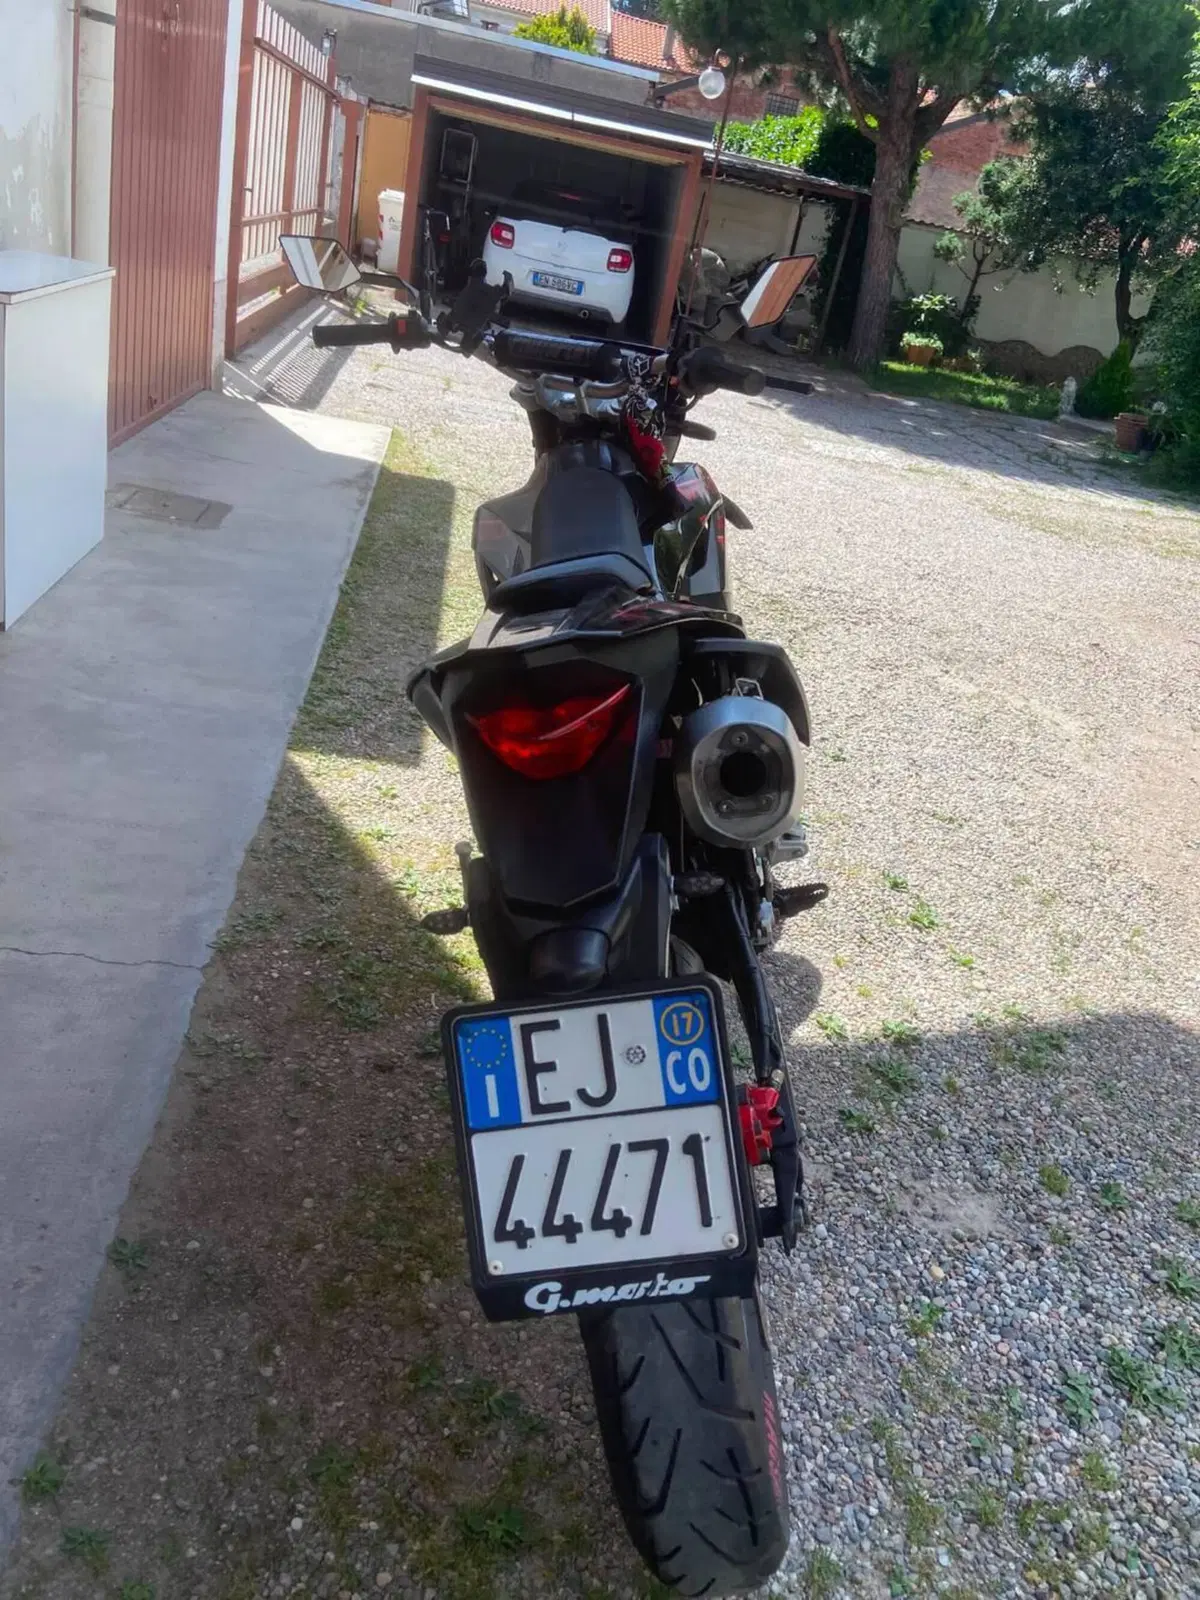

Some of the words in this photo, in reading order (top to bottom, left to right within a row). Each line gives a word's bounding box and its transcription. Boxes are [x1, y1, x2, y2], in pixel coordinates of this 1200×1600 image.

[672, 1011, 693, 1037] 17
[520, 1013, 617, 1115] EJ
[666, 1047, 711, 1095] CO
[484, 1074, 500, 1118] I
[493, 1133, 712, 1250] 44471
